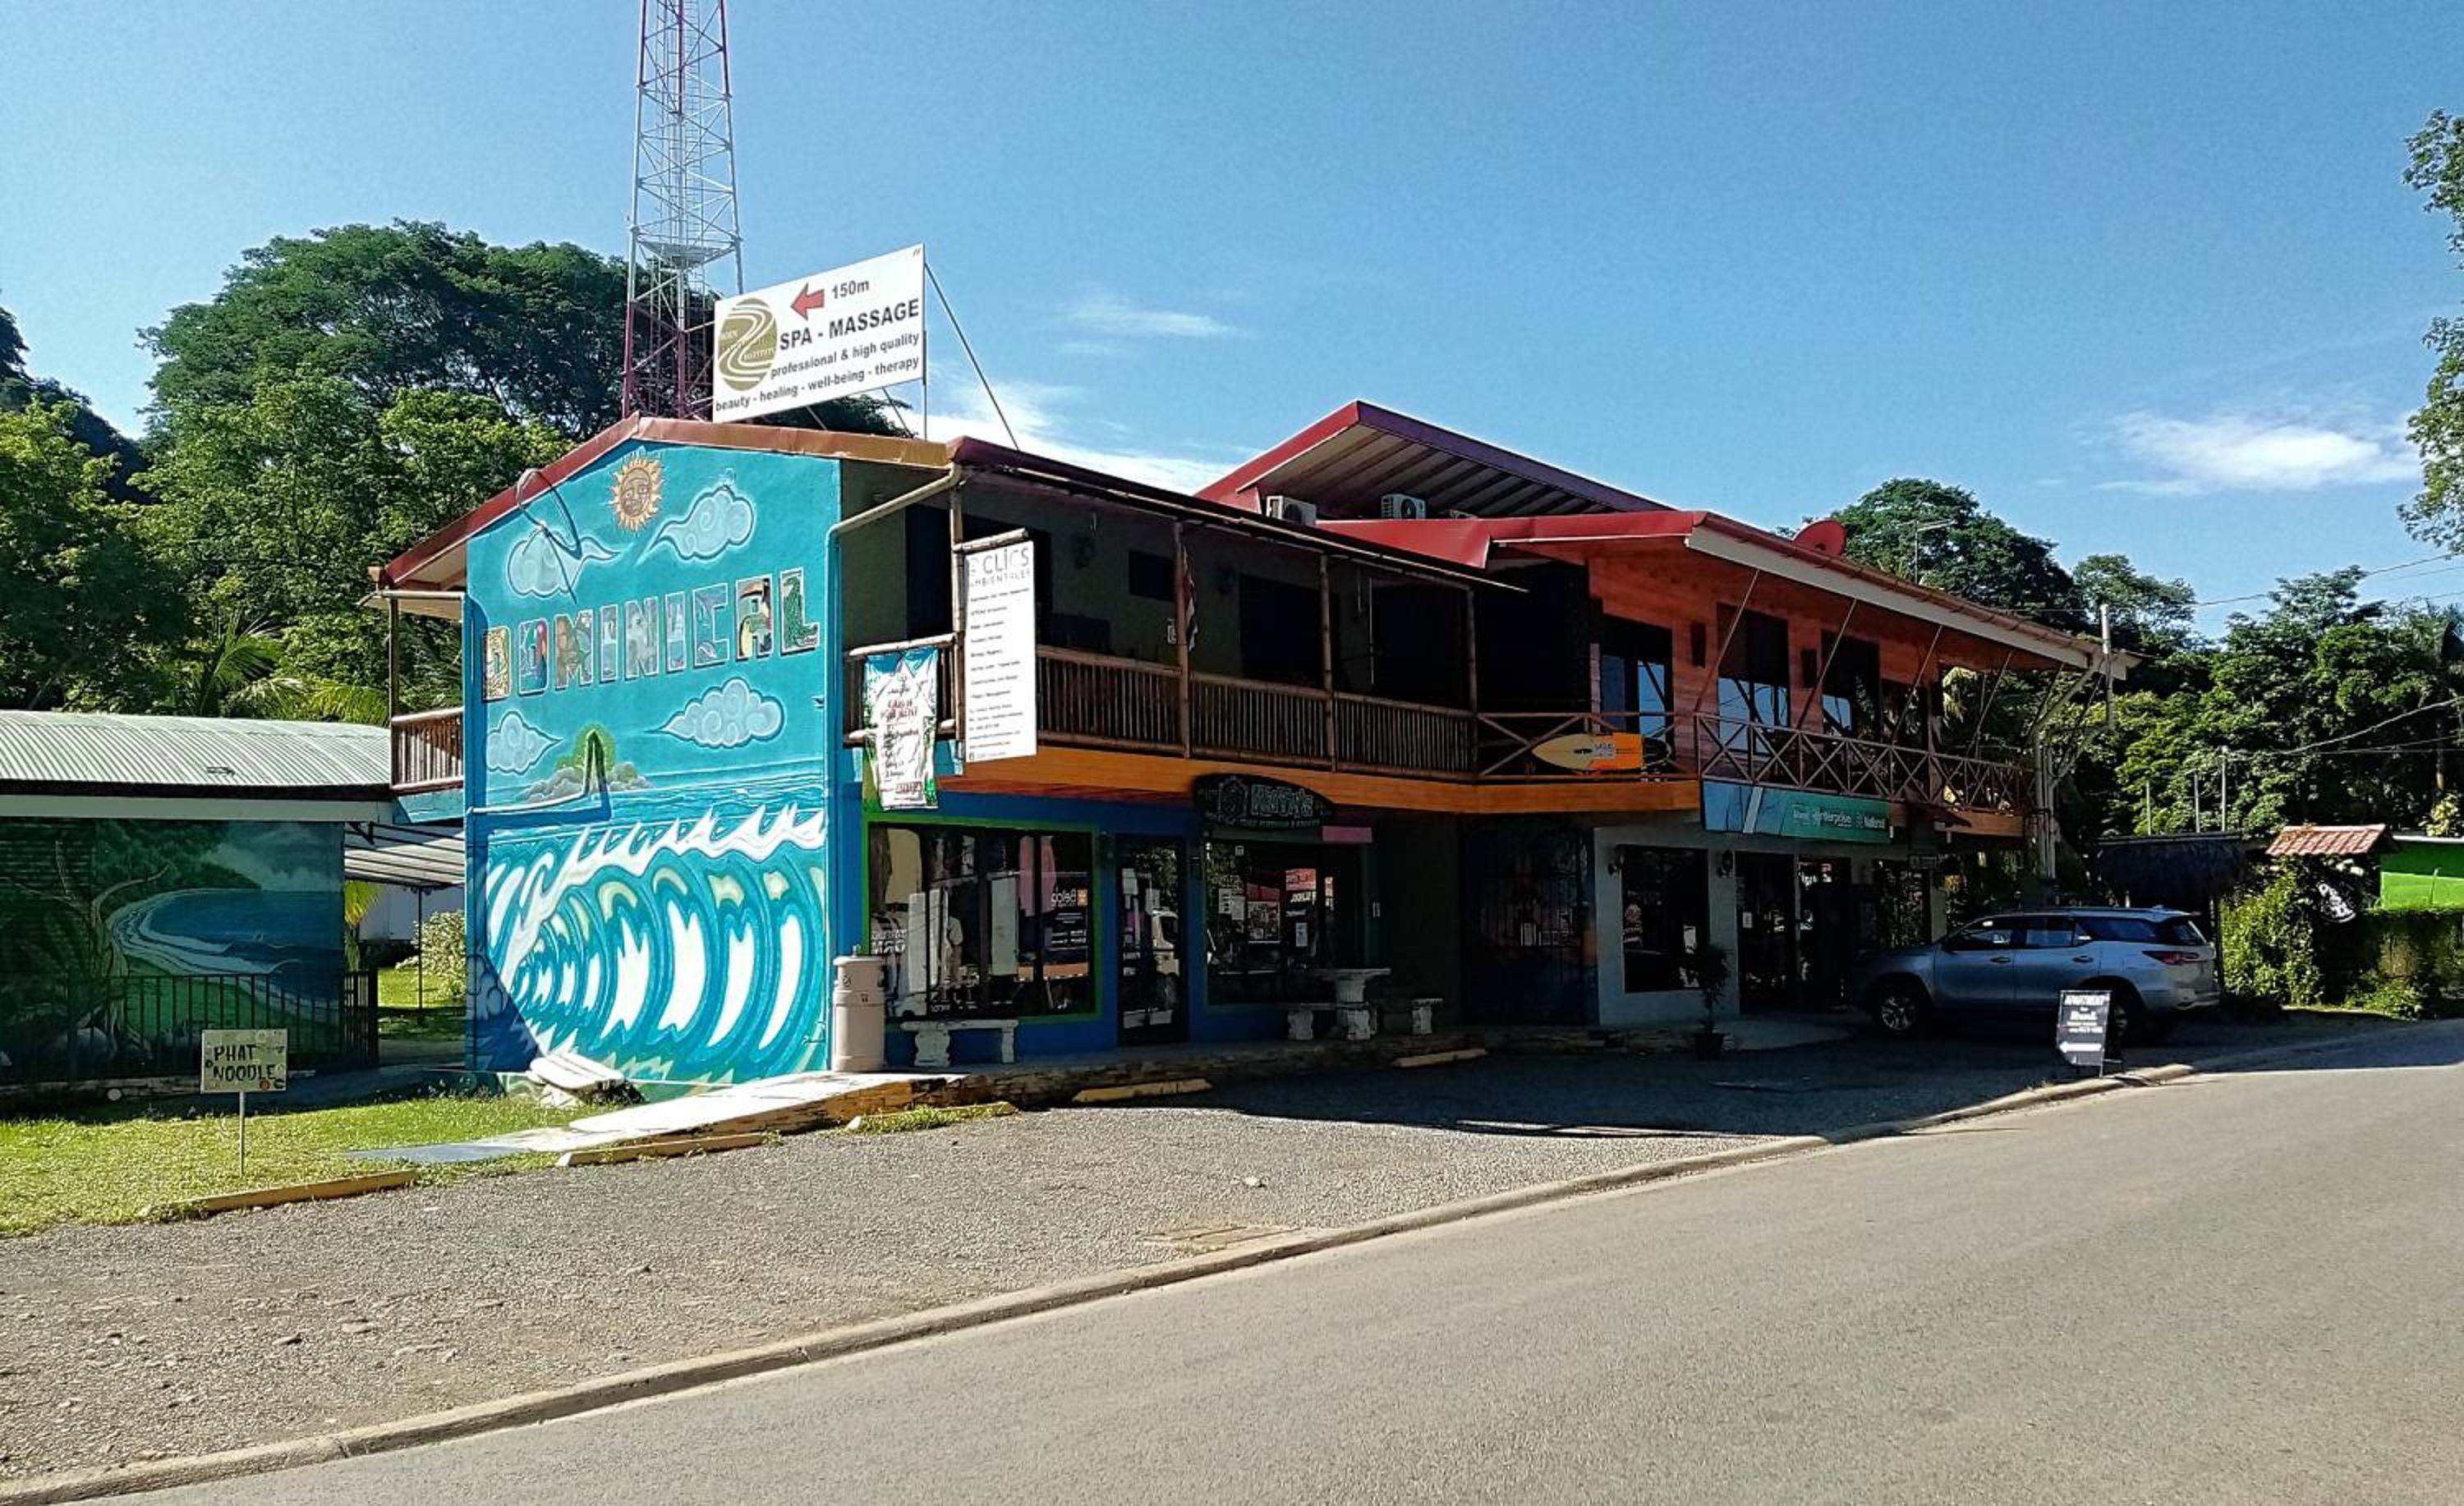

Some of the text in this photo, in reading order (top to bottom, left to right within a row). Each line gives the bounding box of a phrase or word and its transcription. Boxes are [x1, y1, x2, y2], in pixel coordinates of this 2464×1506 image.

[832, 280, 870, 299] 150m
[779, 327, 812, 351] SPA
[829, 298, 919, 339] MASSAGE
[770, 333, 920, 380] professional & high quality
[715, 396, 752, 411] beauty
[760, 383, 798, 403] healing
[807, 370, 865, 391] well-being
[875, 356, 920, 375] therapy
[483, 567, 820, 702] DOMINICAL
[214, 1045, 256, 1061] PHAT
[214, 1064, 276, 1082] NOODLE
